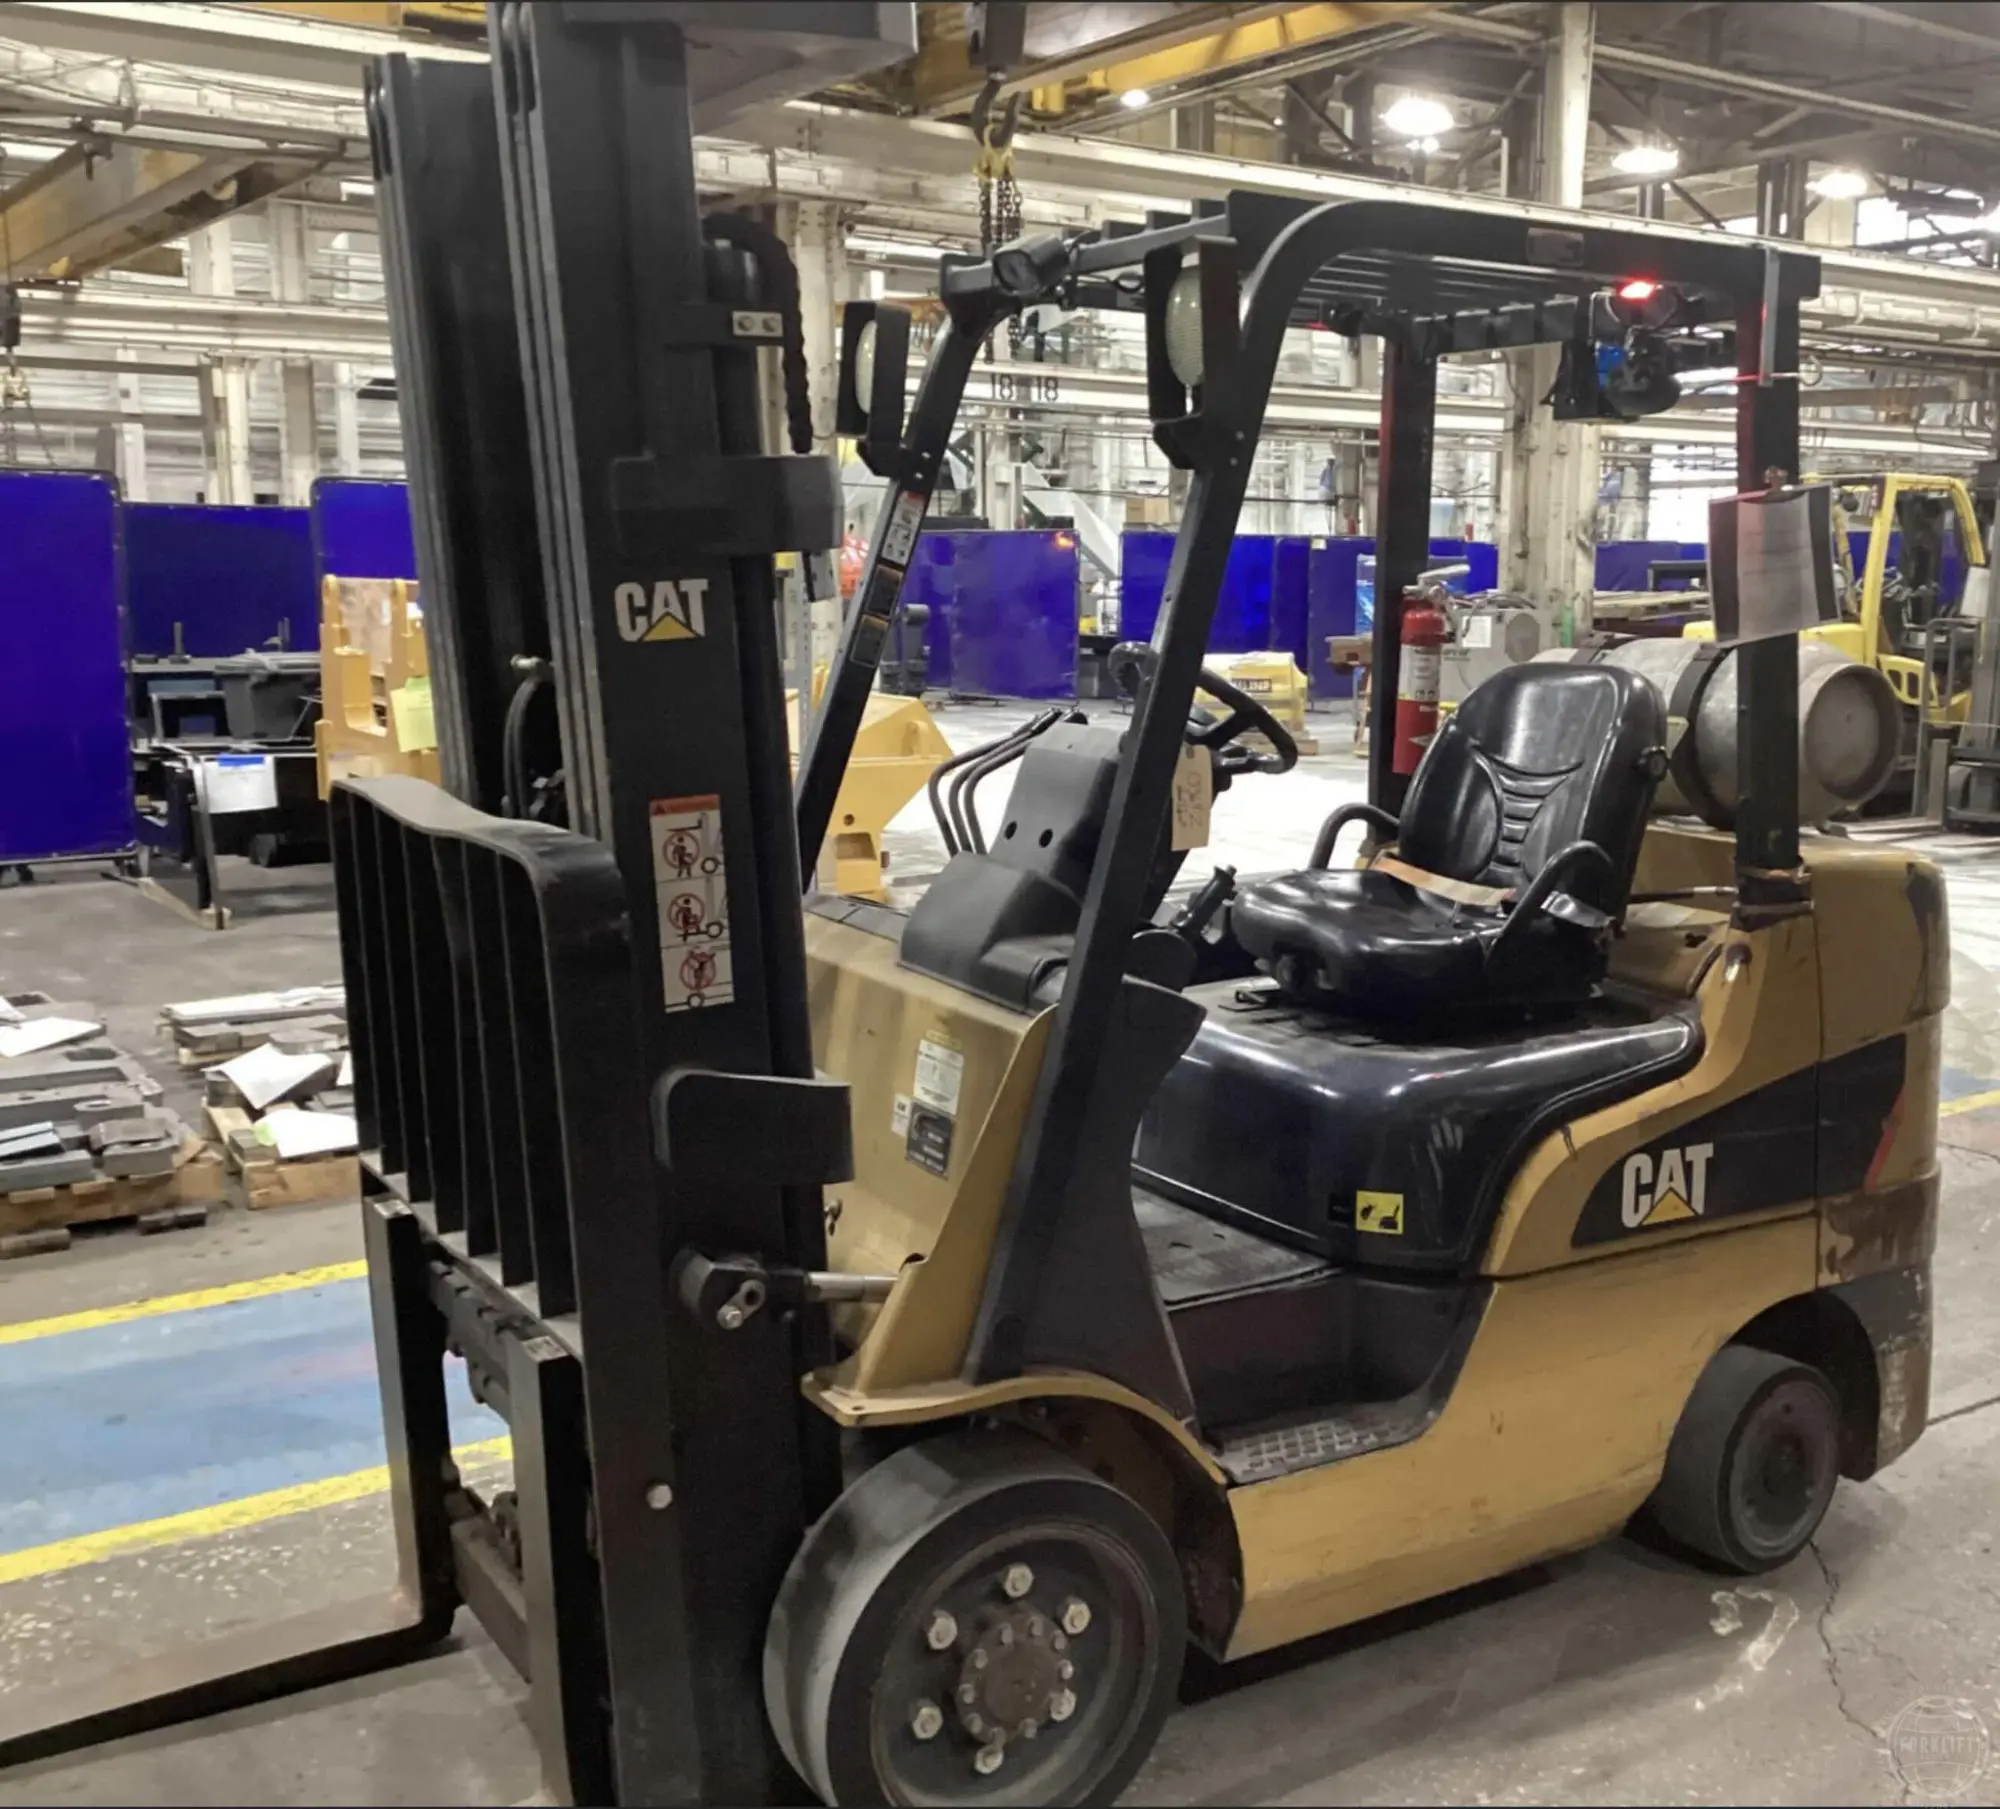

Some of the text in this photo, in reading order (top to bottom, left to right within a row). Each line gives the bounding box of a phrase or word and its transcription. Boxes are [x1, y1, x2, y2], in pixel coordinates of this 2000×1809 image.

[991, 373, 1059, 401] 18 18
[614, 578, 709, 642] CAT
[1621, 1142, 1714, 1228] CAT
